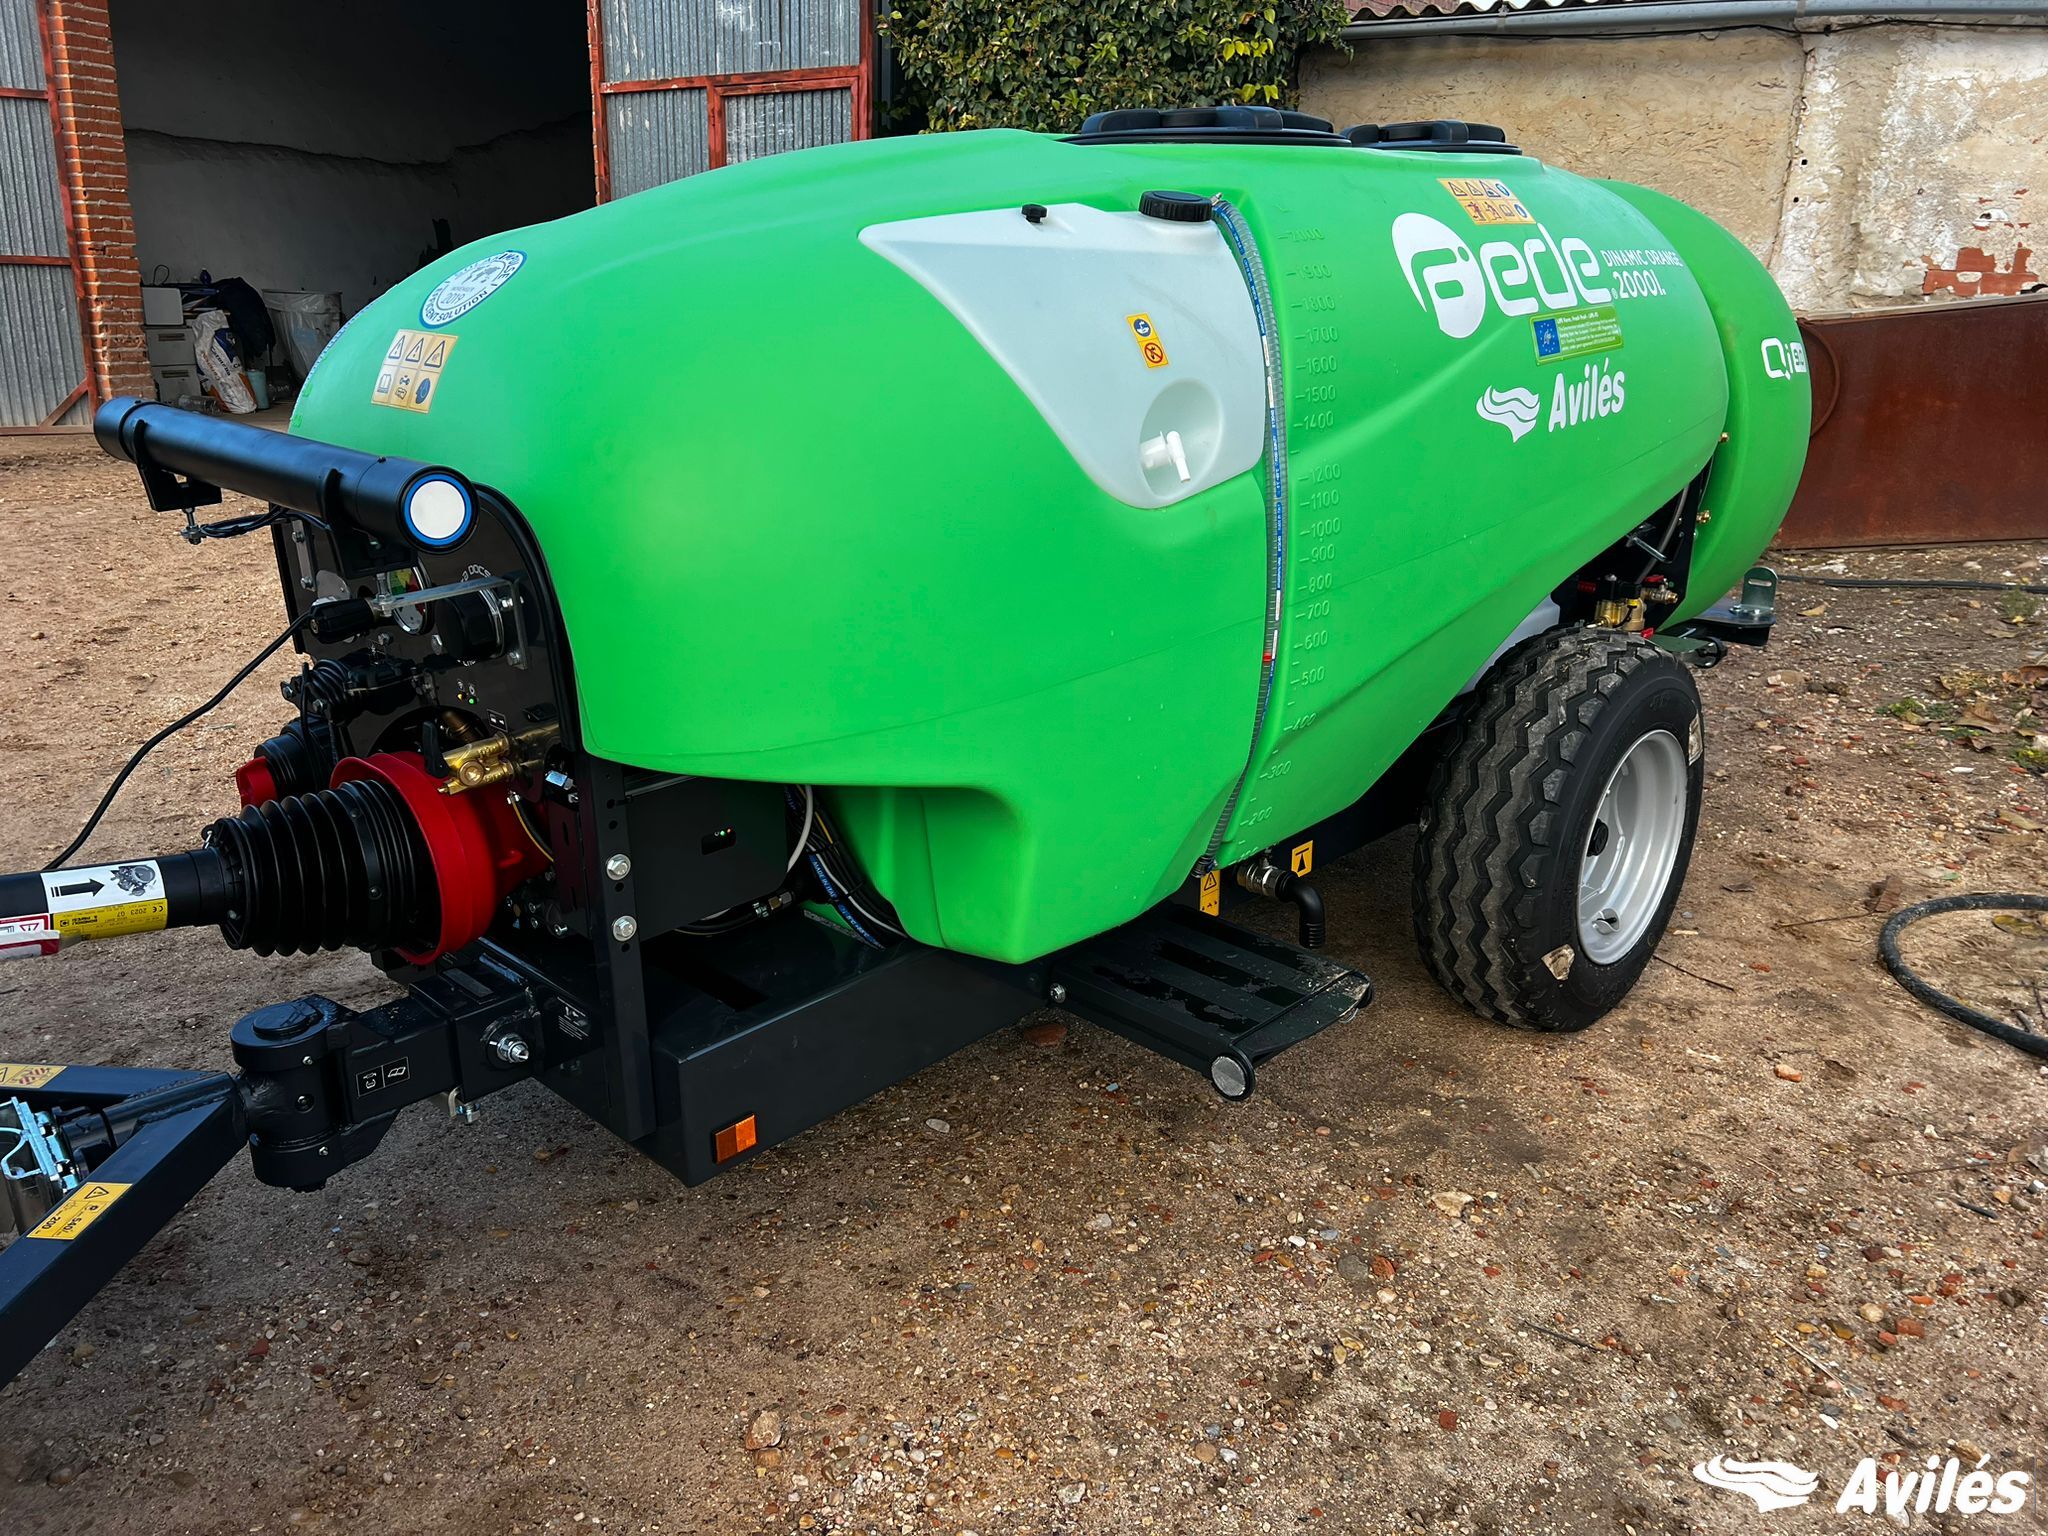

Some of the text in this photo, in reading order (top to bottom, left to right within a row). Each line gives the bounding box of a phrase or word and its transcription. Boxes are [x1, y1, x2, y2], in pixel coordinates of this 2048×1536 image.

[1599, 249, 1684, 267] DINAMIC ORANGE
[1548, 358, 1626, 433] Avilés
